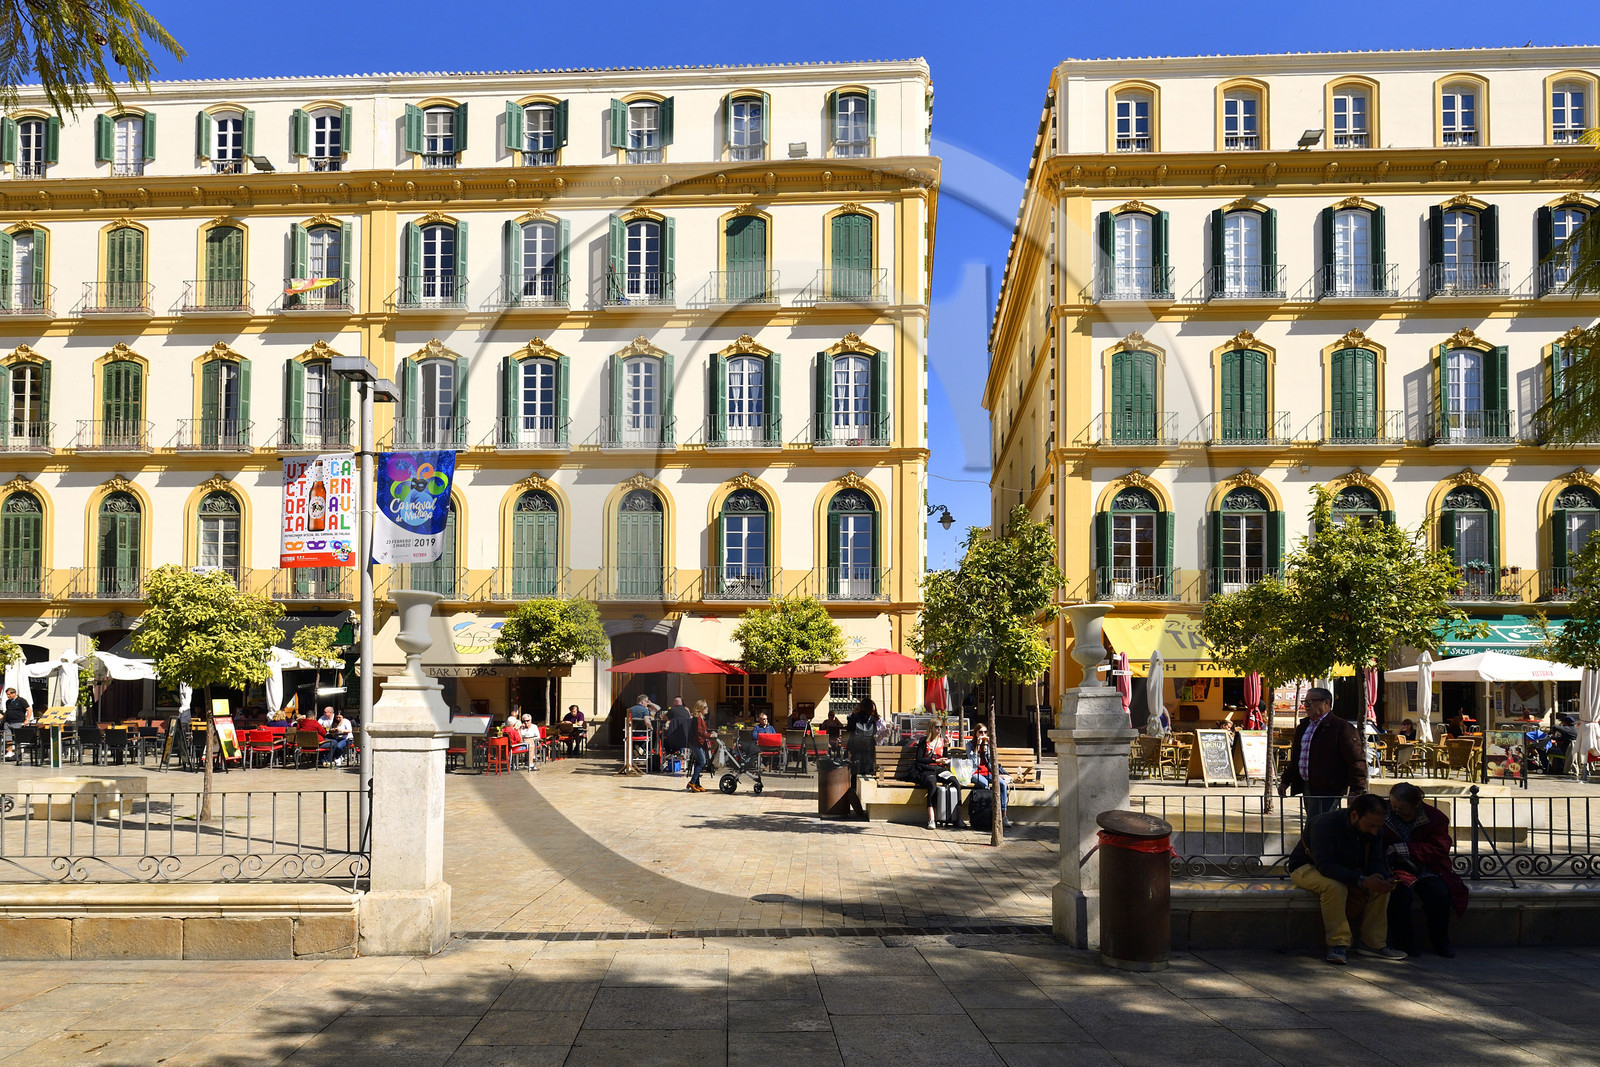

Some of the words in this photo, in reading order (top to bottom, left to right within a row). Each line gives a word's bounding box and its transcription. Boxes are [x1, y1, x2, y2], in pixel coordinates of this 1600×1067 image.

[389, 497, 437, 513] Carnaval
[404, 510, 433, 522] Málaga
[414, 538, 436, 547] 2019
[429, 667, 450, 677] BAR
[453, 667, 461, 676] Y
[465, 667, 497, 677] TAPAS
